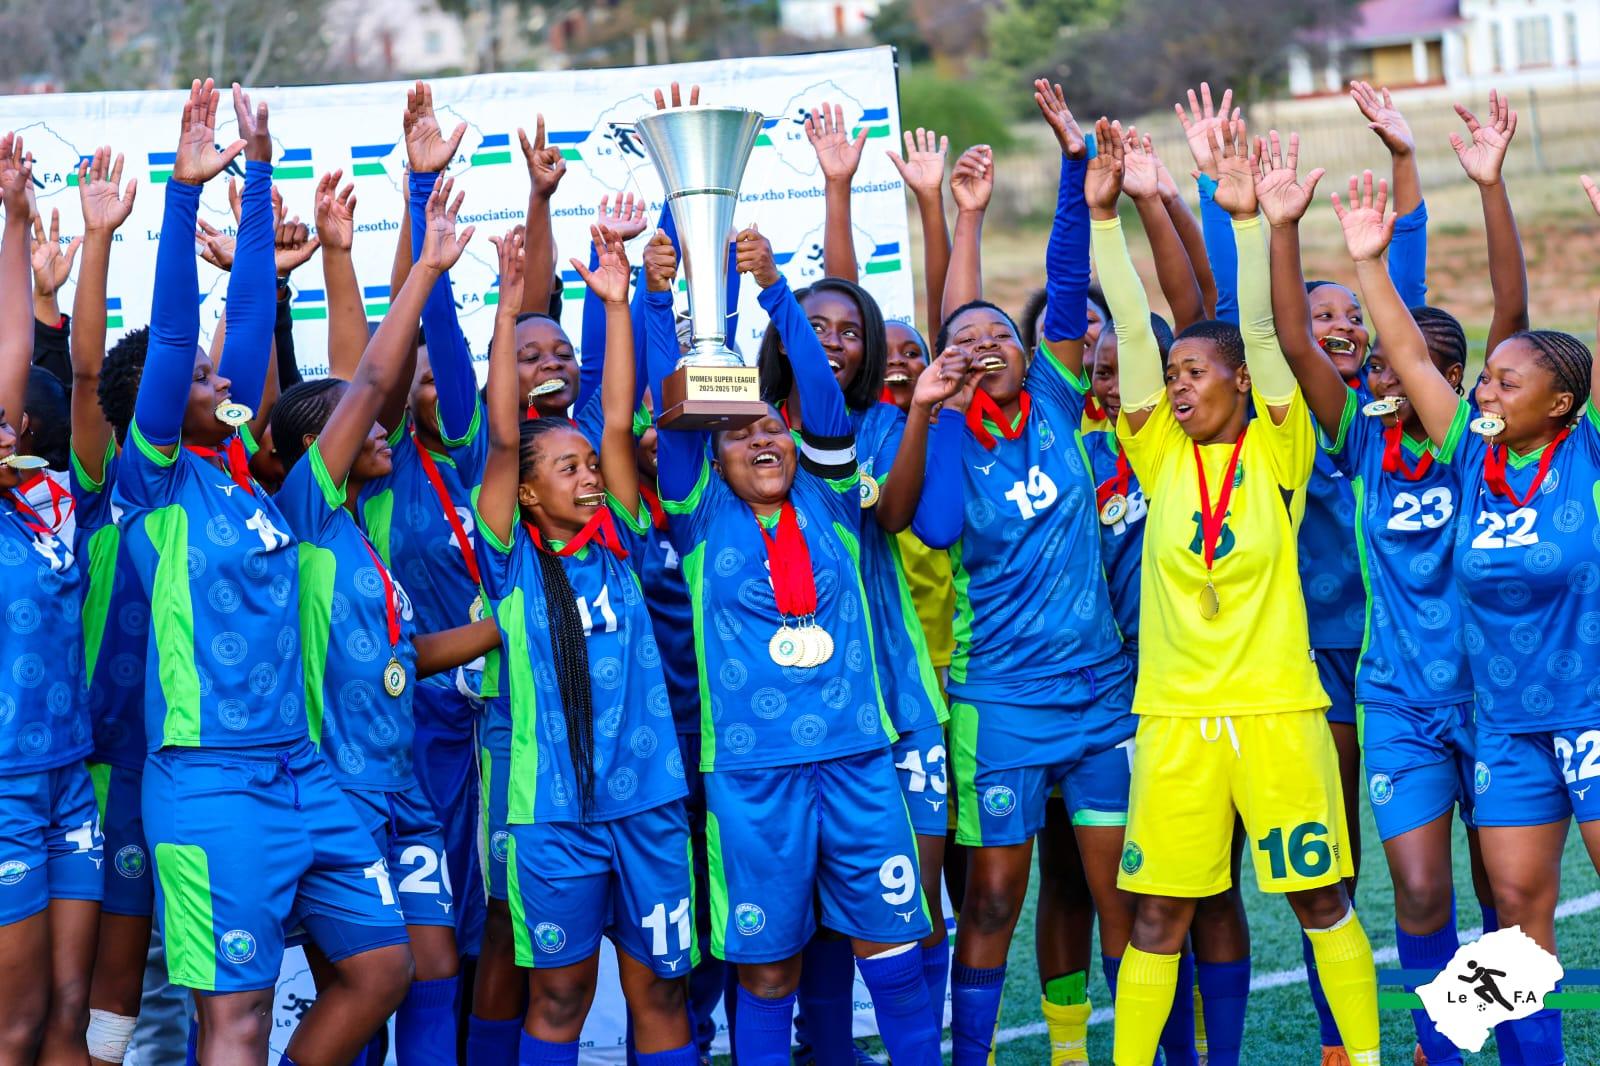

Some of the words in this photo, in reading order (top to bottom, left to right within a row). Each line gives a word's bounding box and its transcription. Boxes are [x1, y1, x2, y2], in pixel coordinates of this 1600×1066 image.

[597, 146, 612, 155] Le
[44, 173, 62, 183] F.A
[788, 186, 827, 199] Footba
[850, 180, 901, 194] sociation
[353, 219, 399, 232] esotho
[456, 208, 525, 224] Association
[552, 205, 595, 217] esotho
[462, 293, 479, 303] F.A
[1004, 465, 1058, 520] 19
[1387, 486, 1453, 531] 23
[1471, 507, 1539, 549] 22
[895, 744, 947, 795] 13
[1553, 730, 1600, 785] 22
[1258, 821, 1331, 879] 16
[878, 854, 916, 906] 9
[641, 897, 691, 956] 11
[276, 1018, 291, 1028] Le
